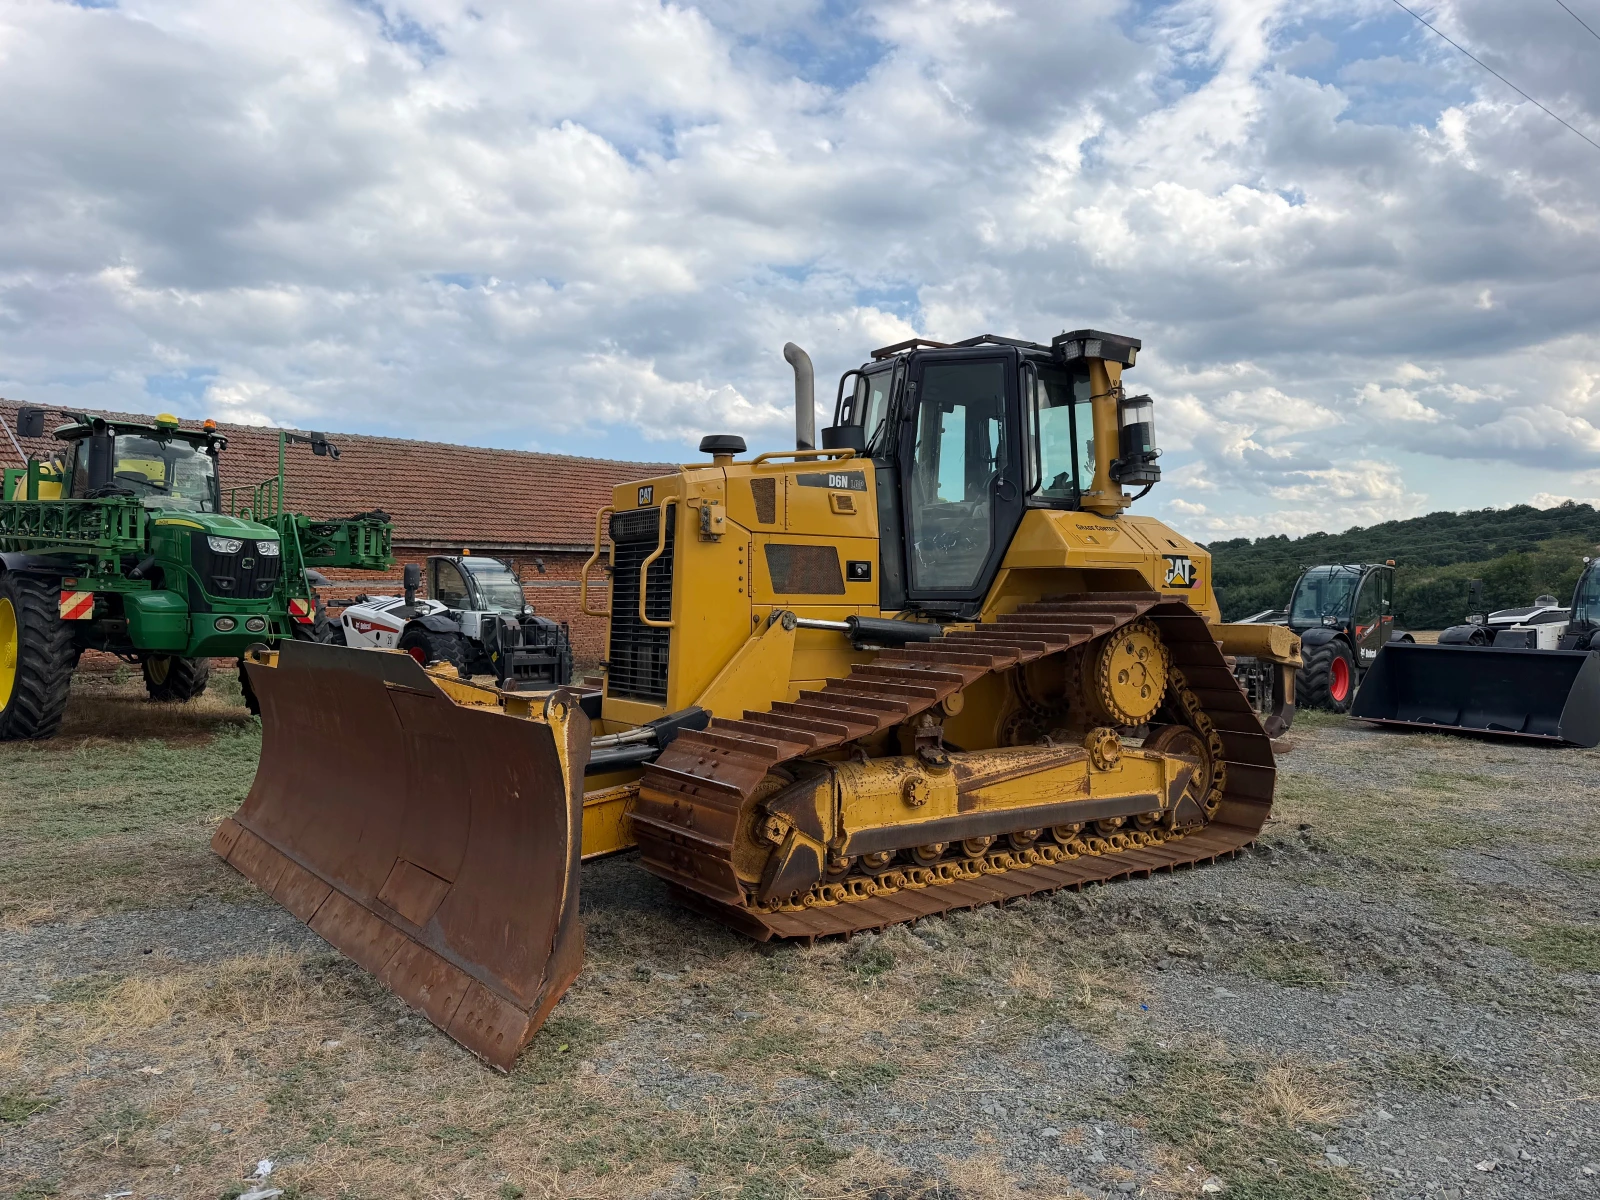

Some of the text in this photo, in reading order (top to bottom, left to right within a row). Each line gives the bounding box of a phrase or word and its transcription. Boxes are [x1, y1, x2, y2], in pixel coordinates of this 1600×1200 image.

[828, 474, 848, 488] D6N
[639, 487, 652, 505] CAT
[1164, 558, 1192, 585] CAT
